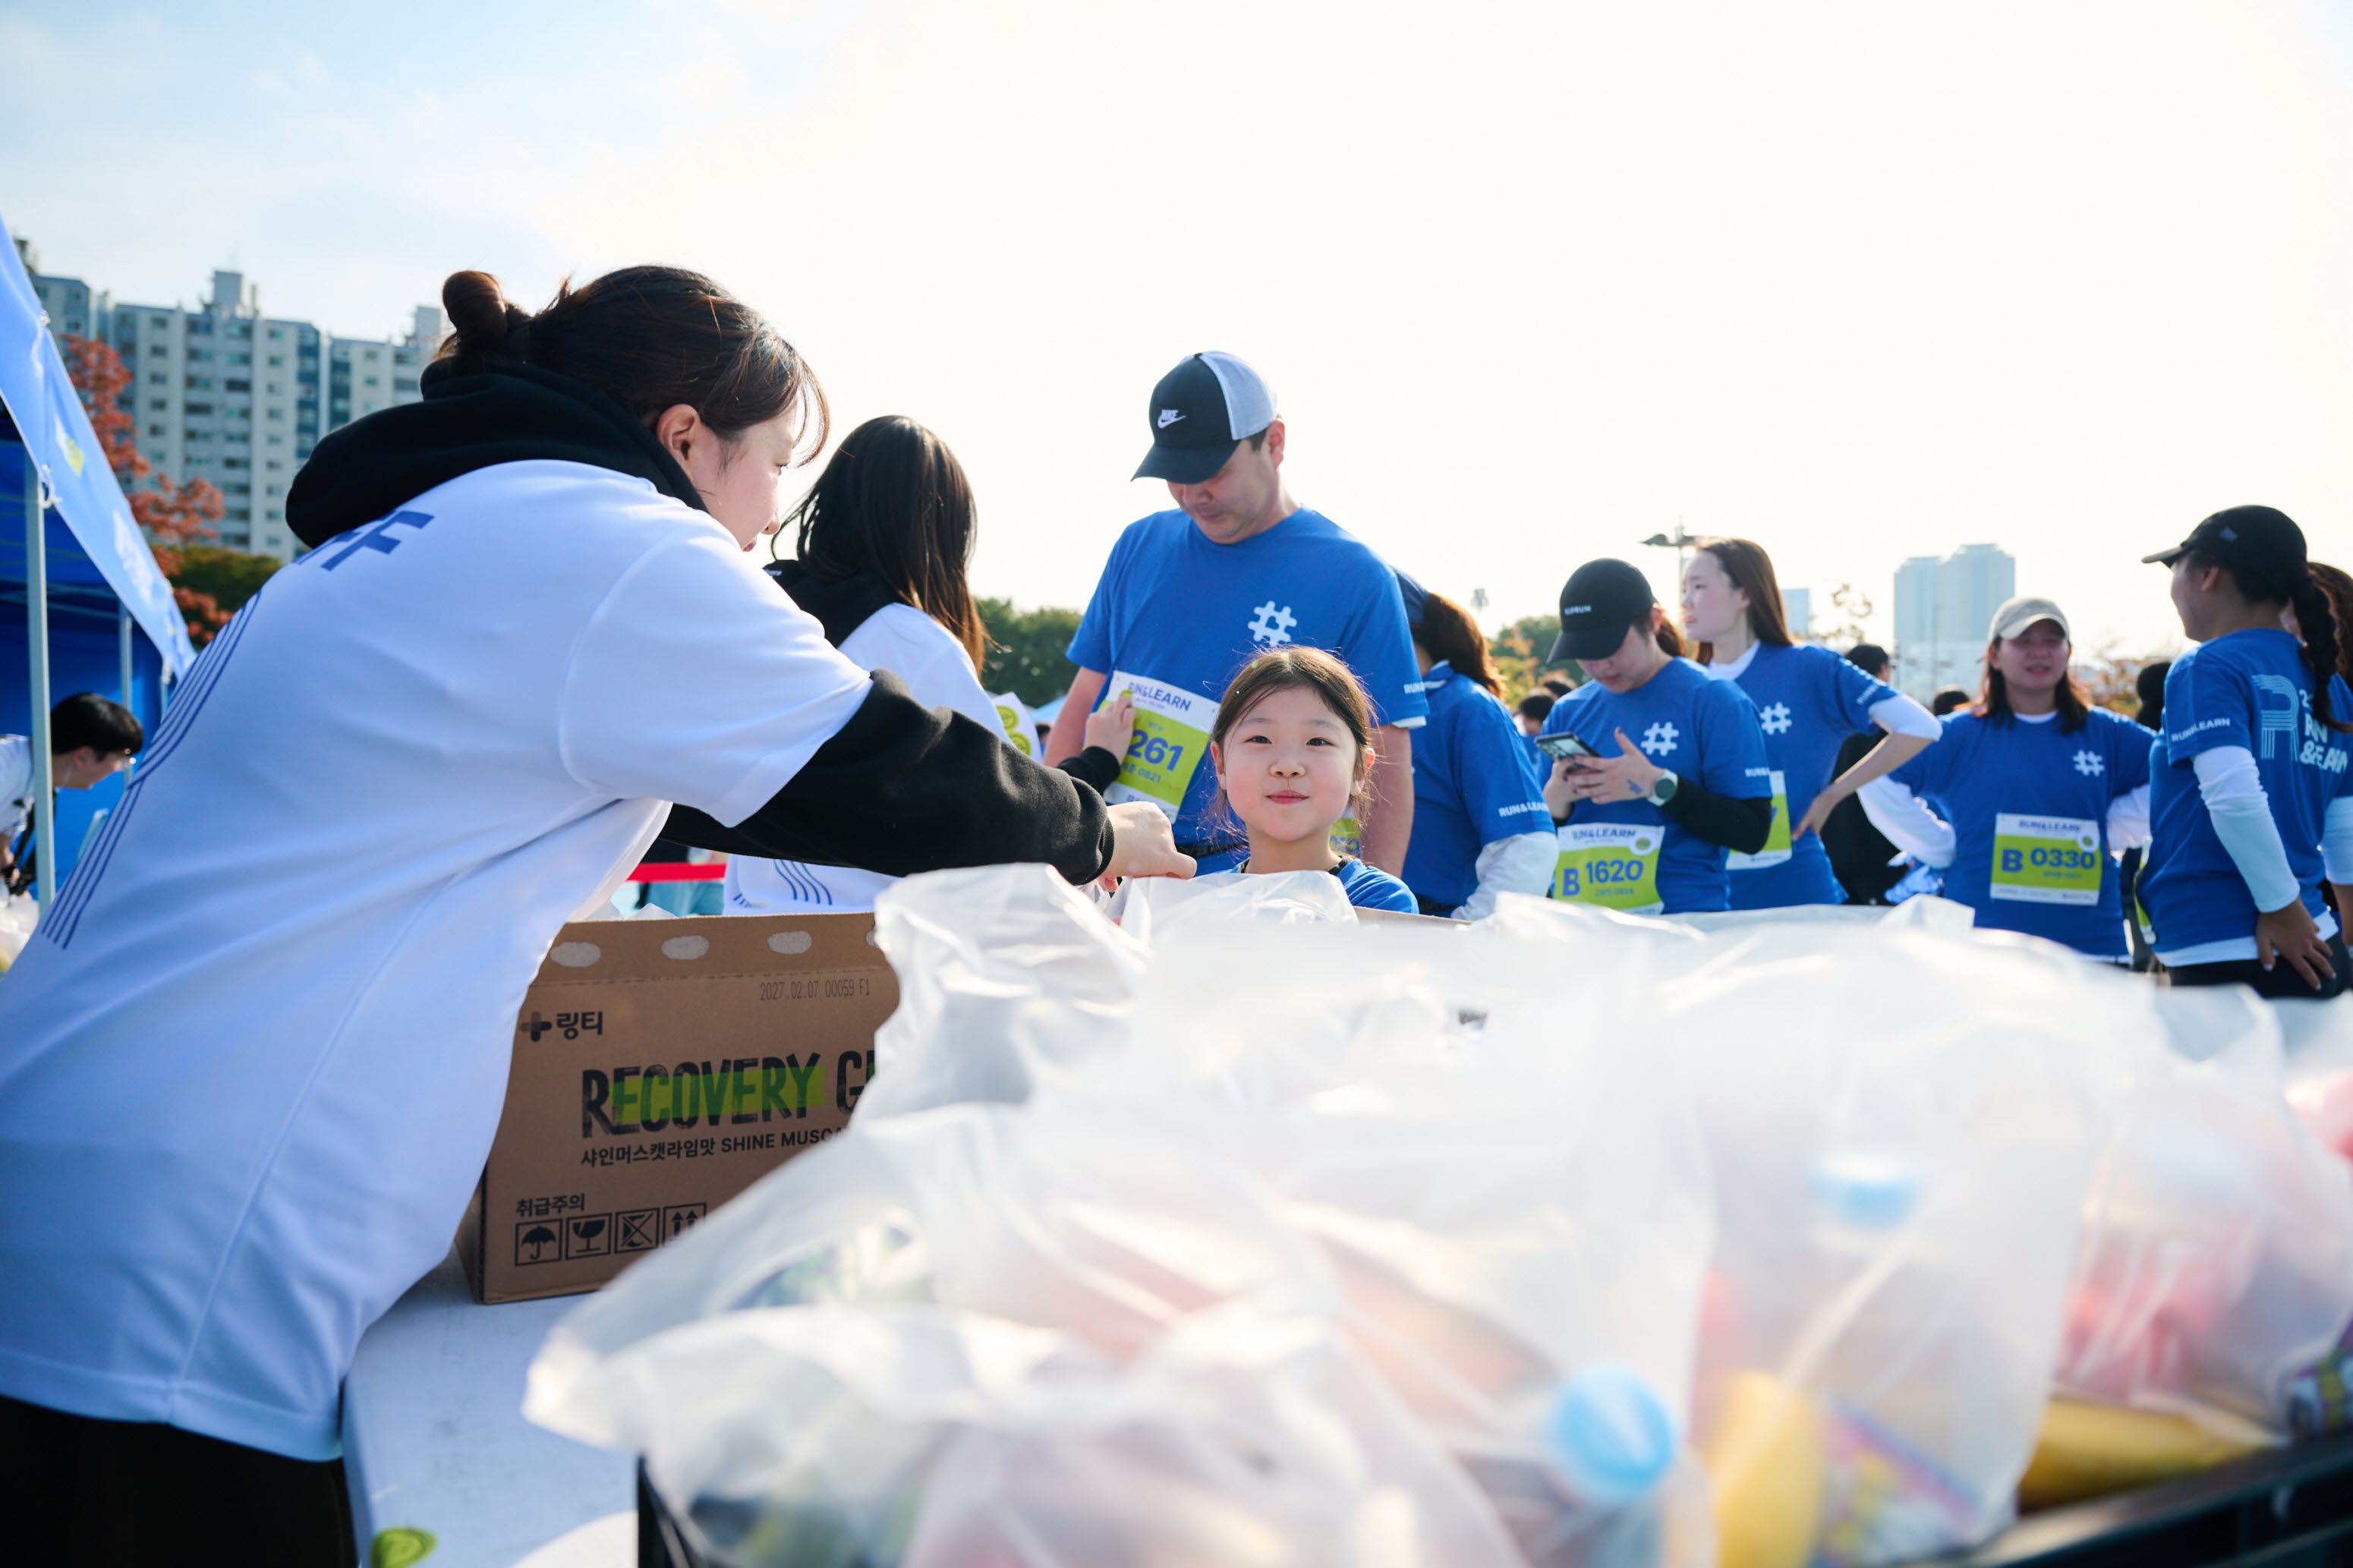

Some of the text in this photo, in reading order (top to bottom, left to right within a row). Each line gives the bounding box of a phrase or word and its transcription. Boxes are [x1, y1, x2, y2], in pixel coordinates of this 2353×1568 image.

[2002, 847, 2096, 873] B 0330
[1562, 858, 1644, 896] B 1620
[760, 980, 820, 1001] 2027.02.07
[859, 978, 870, 997] F1
[556, 1011, 603, 1040] 링티
[581, 1052, 821, 1138] RECOVERY
[721, 1133, 775, 1152] SHINE
[516, 1193, 584, 1217] 취급주의
